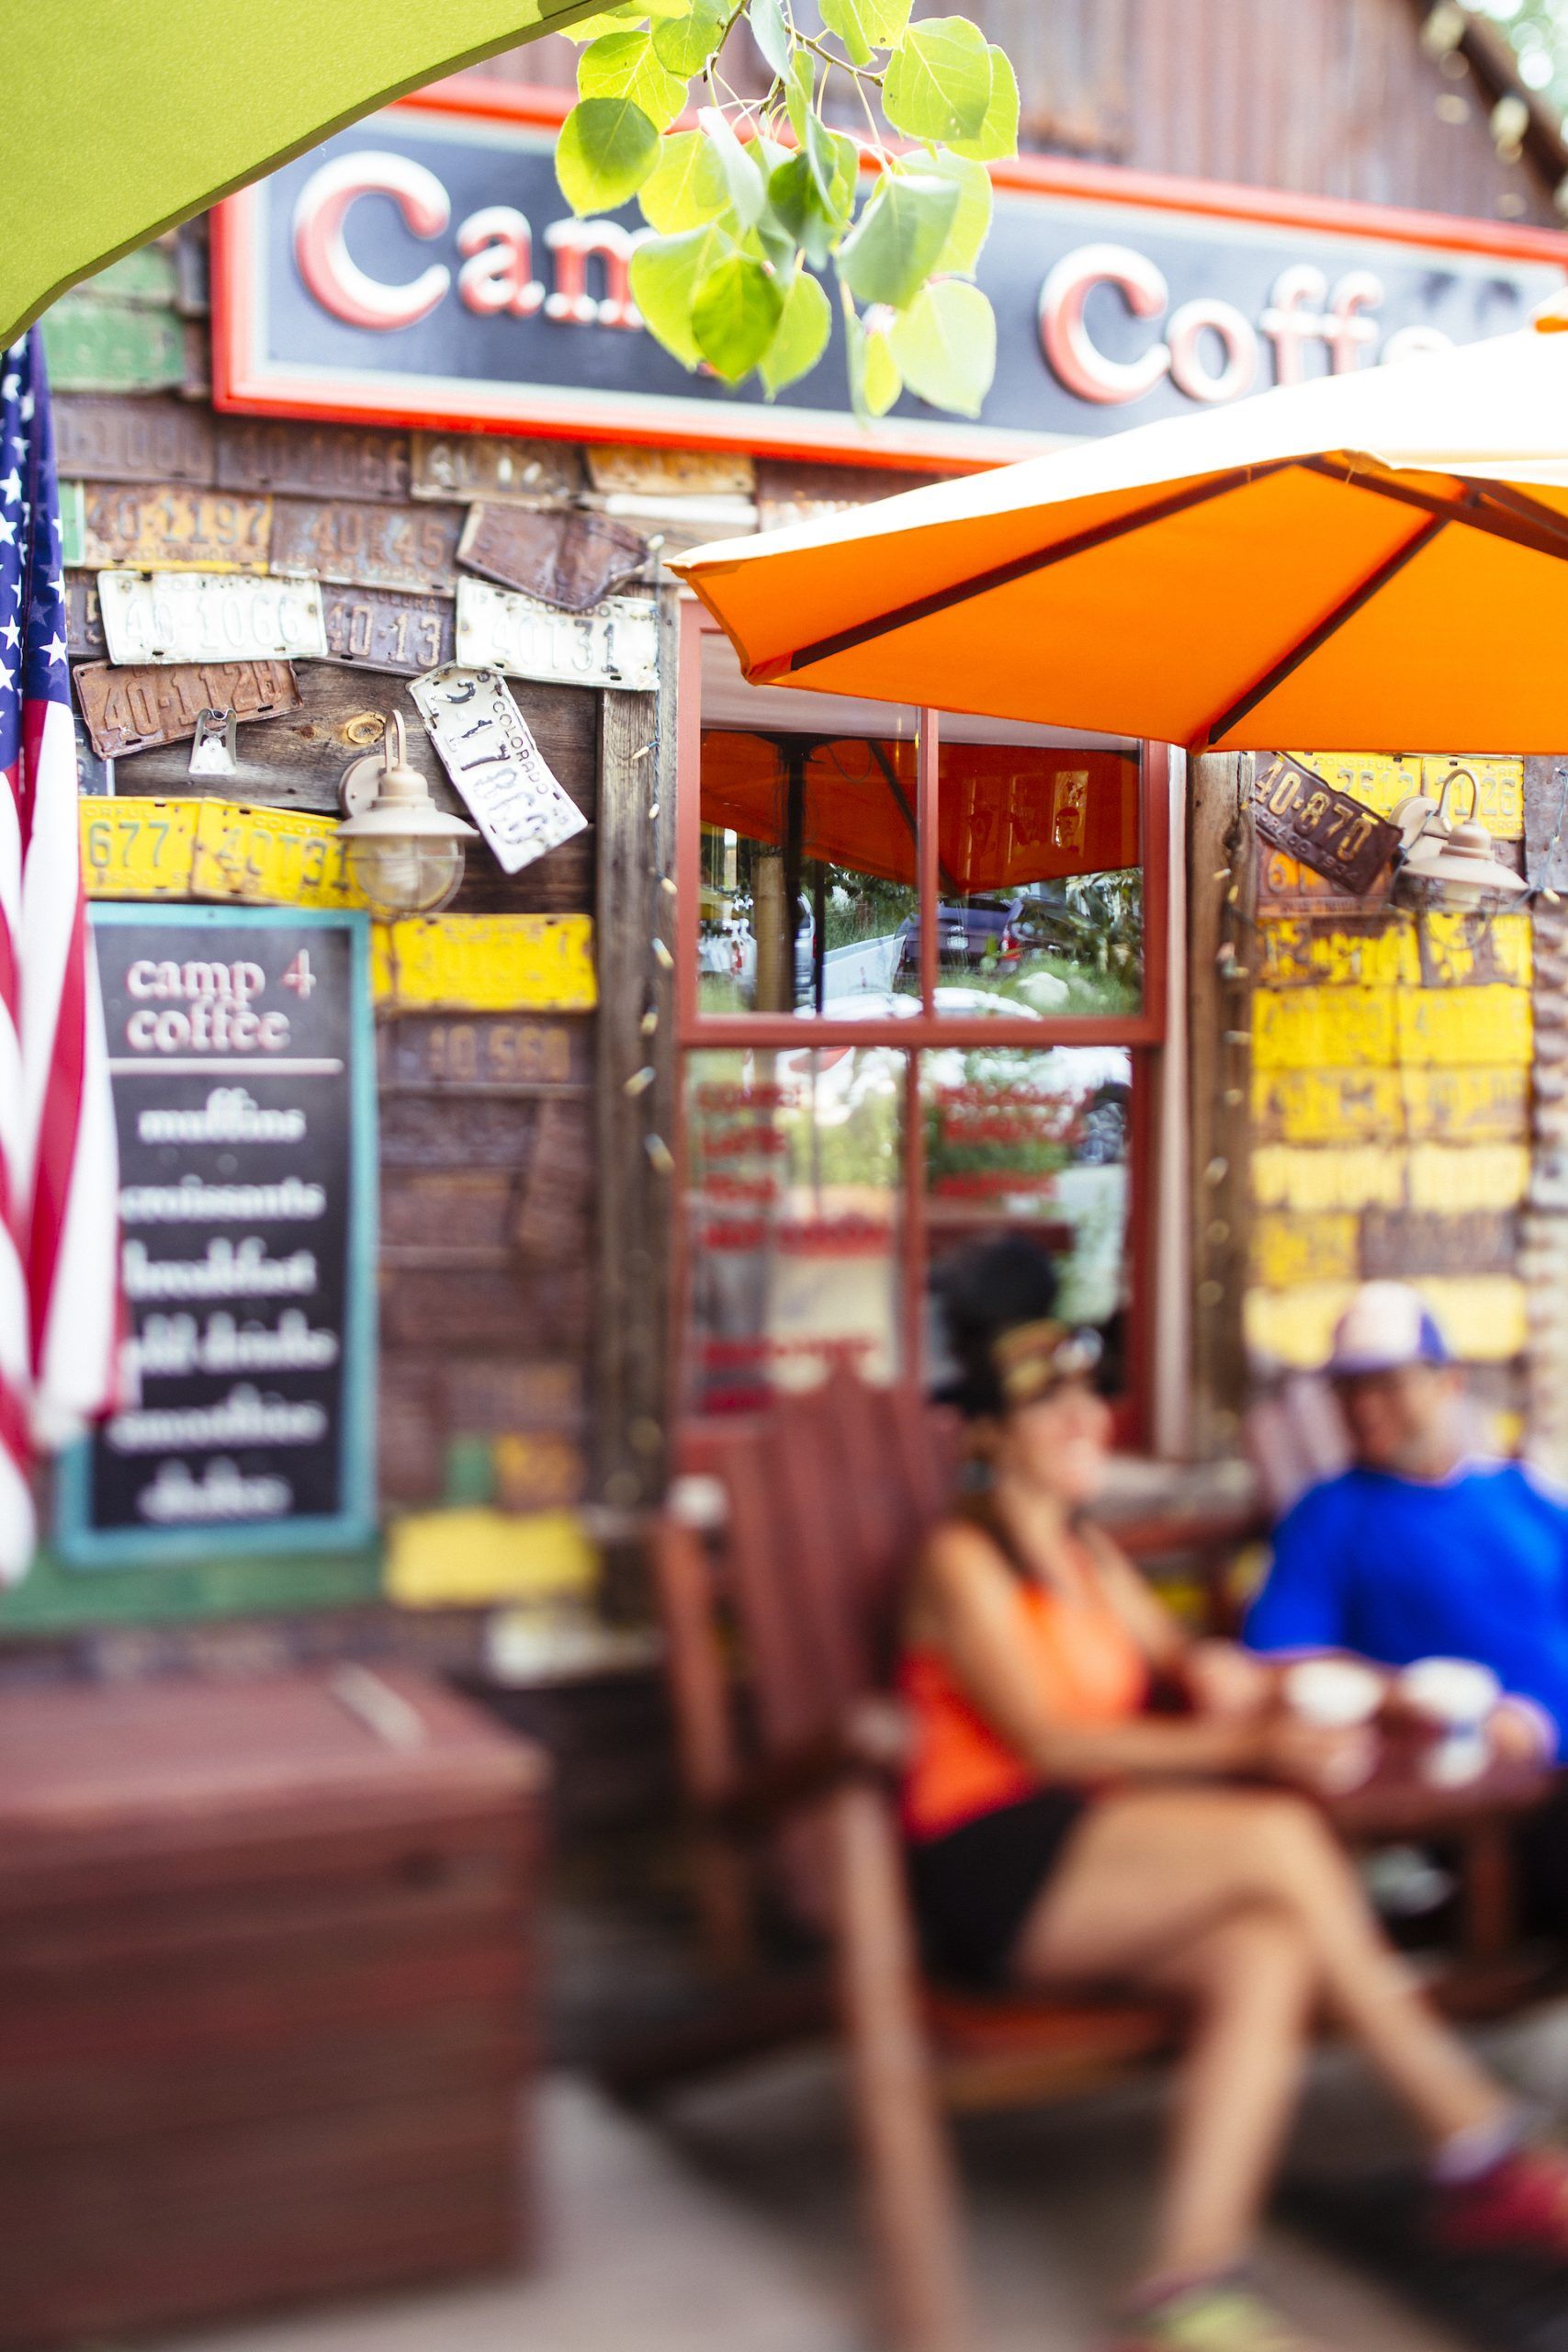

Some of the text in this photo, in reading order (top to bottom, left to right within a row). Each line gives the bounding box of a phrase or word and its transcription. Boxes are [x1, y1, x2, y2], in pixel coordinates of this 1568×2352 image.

[294, 149, 1459, 404] Cam Coff
[492, 699, 549, 796] COLORADO
[127, 948, 317, 1008] camp 4
[126, 994, 291, 1052] coffee
